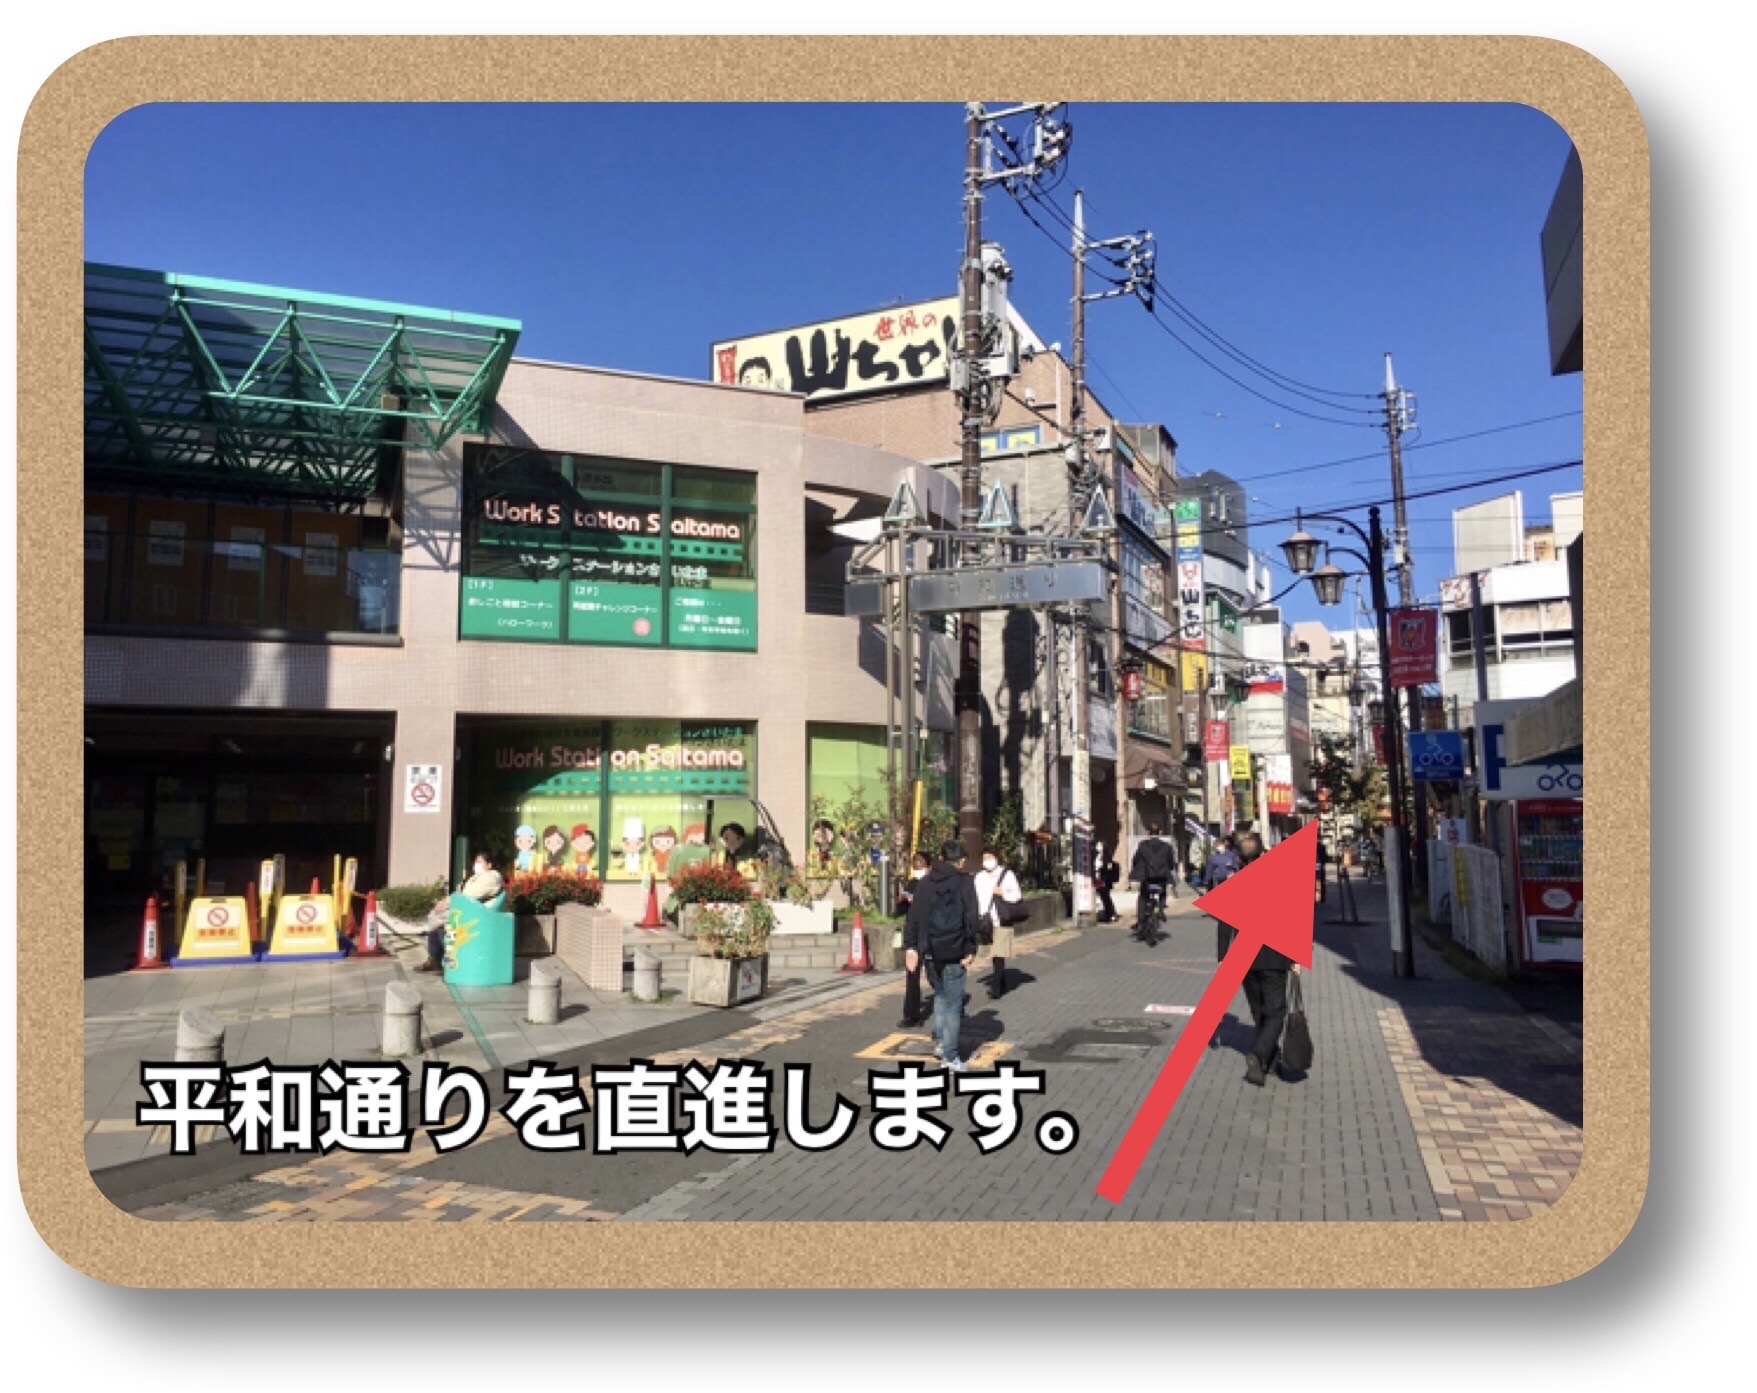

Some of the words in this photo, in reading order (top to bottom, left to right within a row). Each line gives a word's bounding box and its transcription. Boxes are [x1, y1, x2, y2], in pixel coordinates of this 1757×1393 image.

[873, 309, 937, 341] 世界の
[484, 499, 543, 524] Work
[647, 512, 741, 539] Saitama
[495, 745, 545, 769] Work
[550, 744, 640, 768] Station
[644, 742, 743, 770] Saitama
